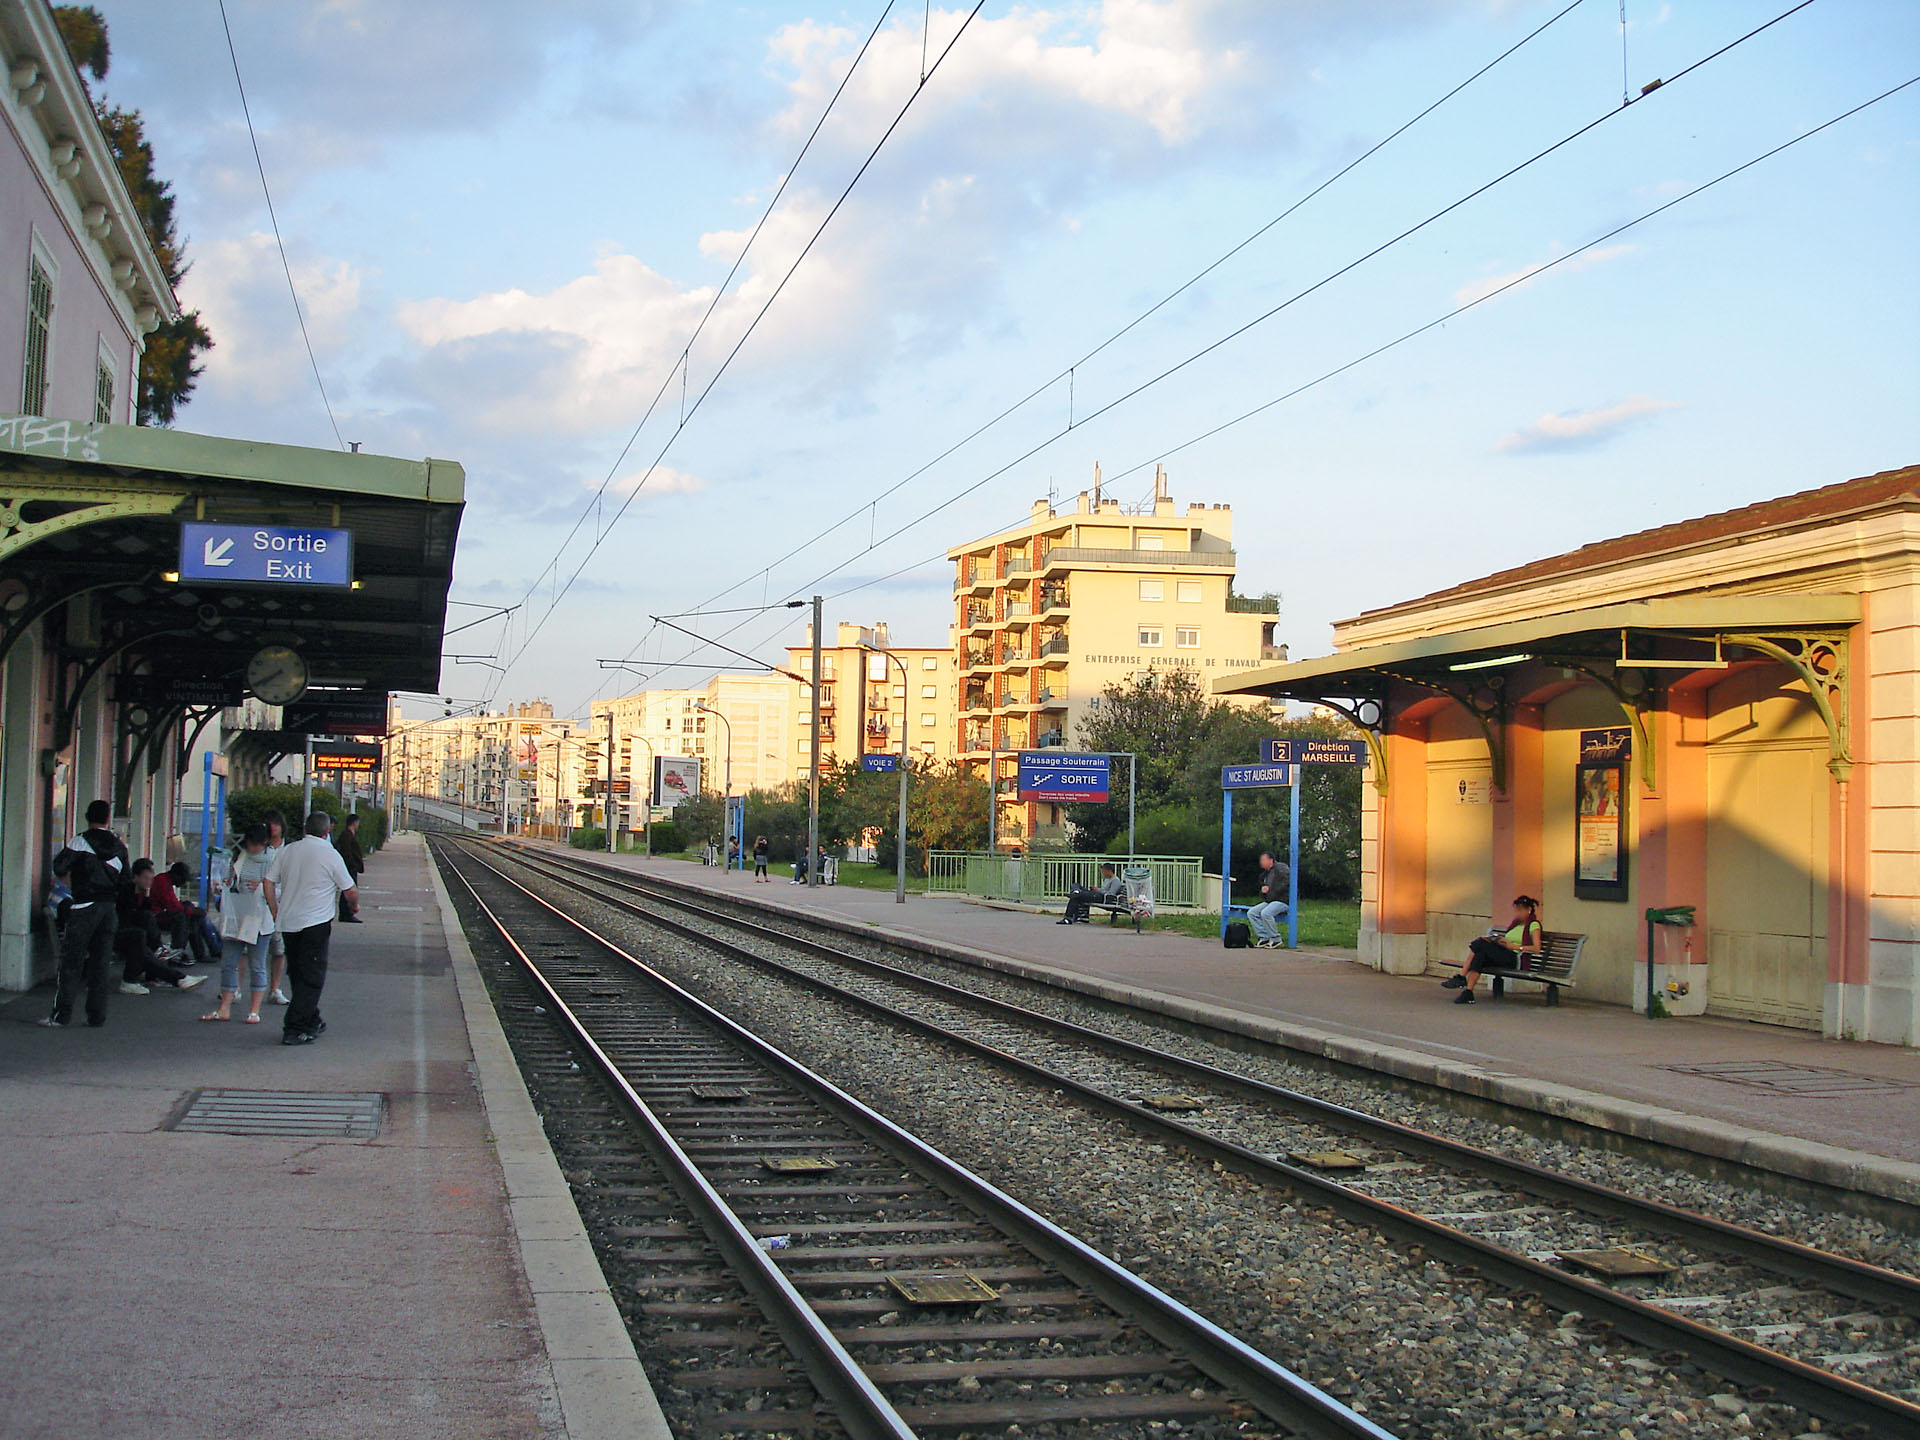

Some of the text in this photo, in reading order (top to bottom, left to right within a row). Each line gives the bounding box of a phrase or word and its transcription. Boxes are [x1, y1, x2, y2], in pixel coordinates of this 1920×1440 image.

[253, 531, 328, 553] Sortie
[266, 559, 312, 580] Exit
[1085, 655, 1261, 668] ENTREPRISE GENERALE DE TRAVAUX
[172, 679, 224, 690] Direction
[1308, 741, 1350, 752] Direction
[1278, 748, 1286, 759] 2
[1301, 753, 1357, 763] MARSEILLE
[868, 759, 893, 767] VOIE 2
[1025, 756, 1105, 766] Passage Souterrain
[1060, 775, 1098, 785] SORTIE
[1228, 768, 1283, 782] NICE ST AUGUSTIN
